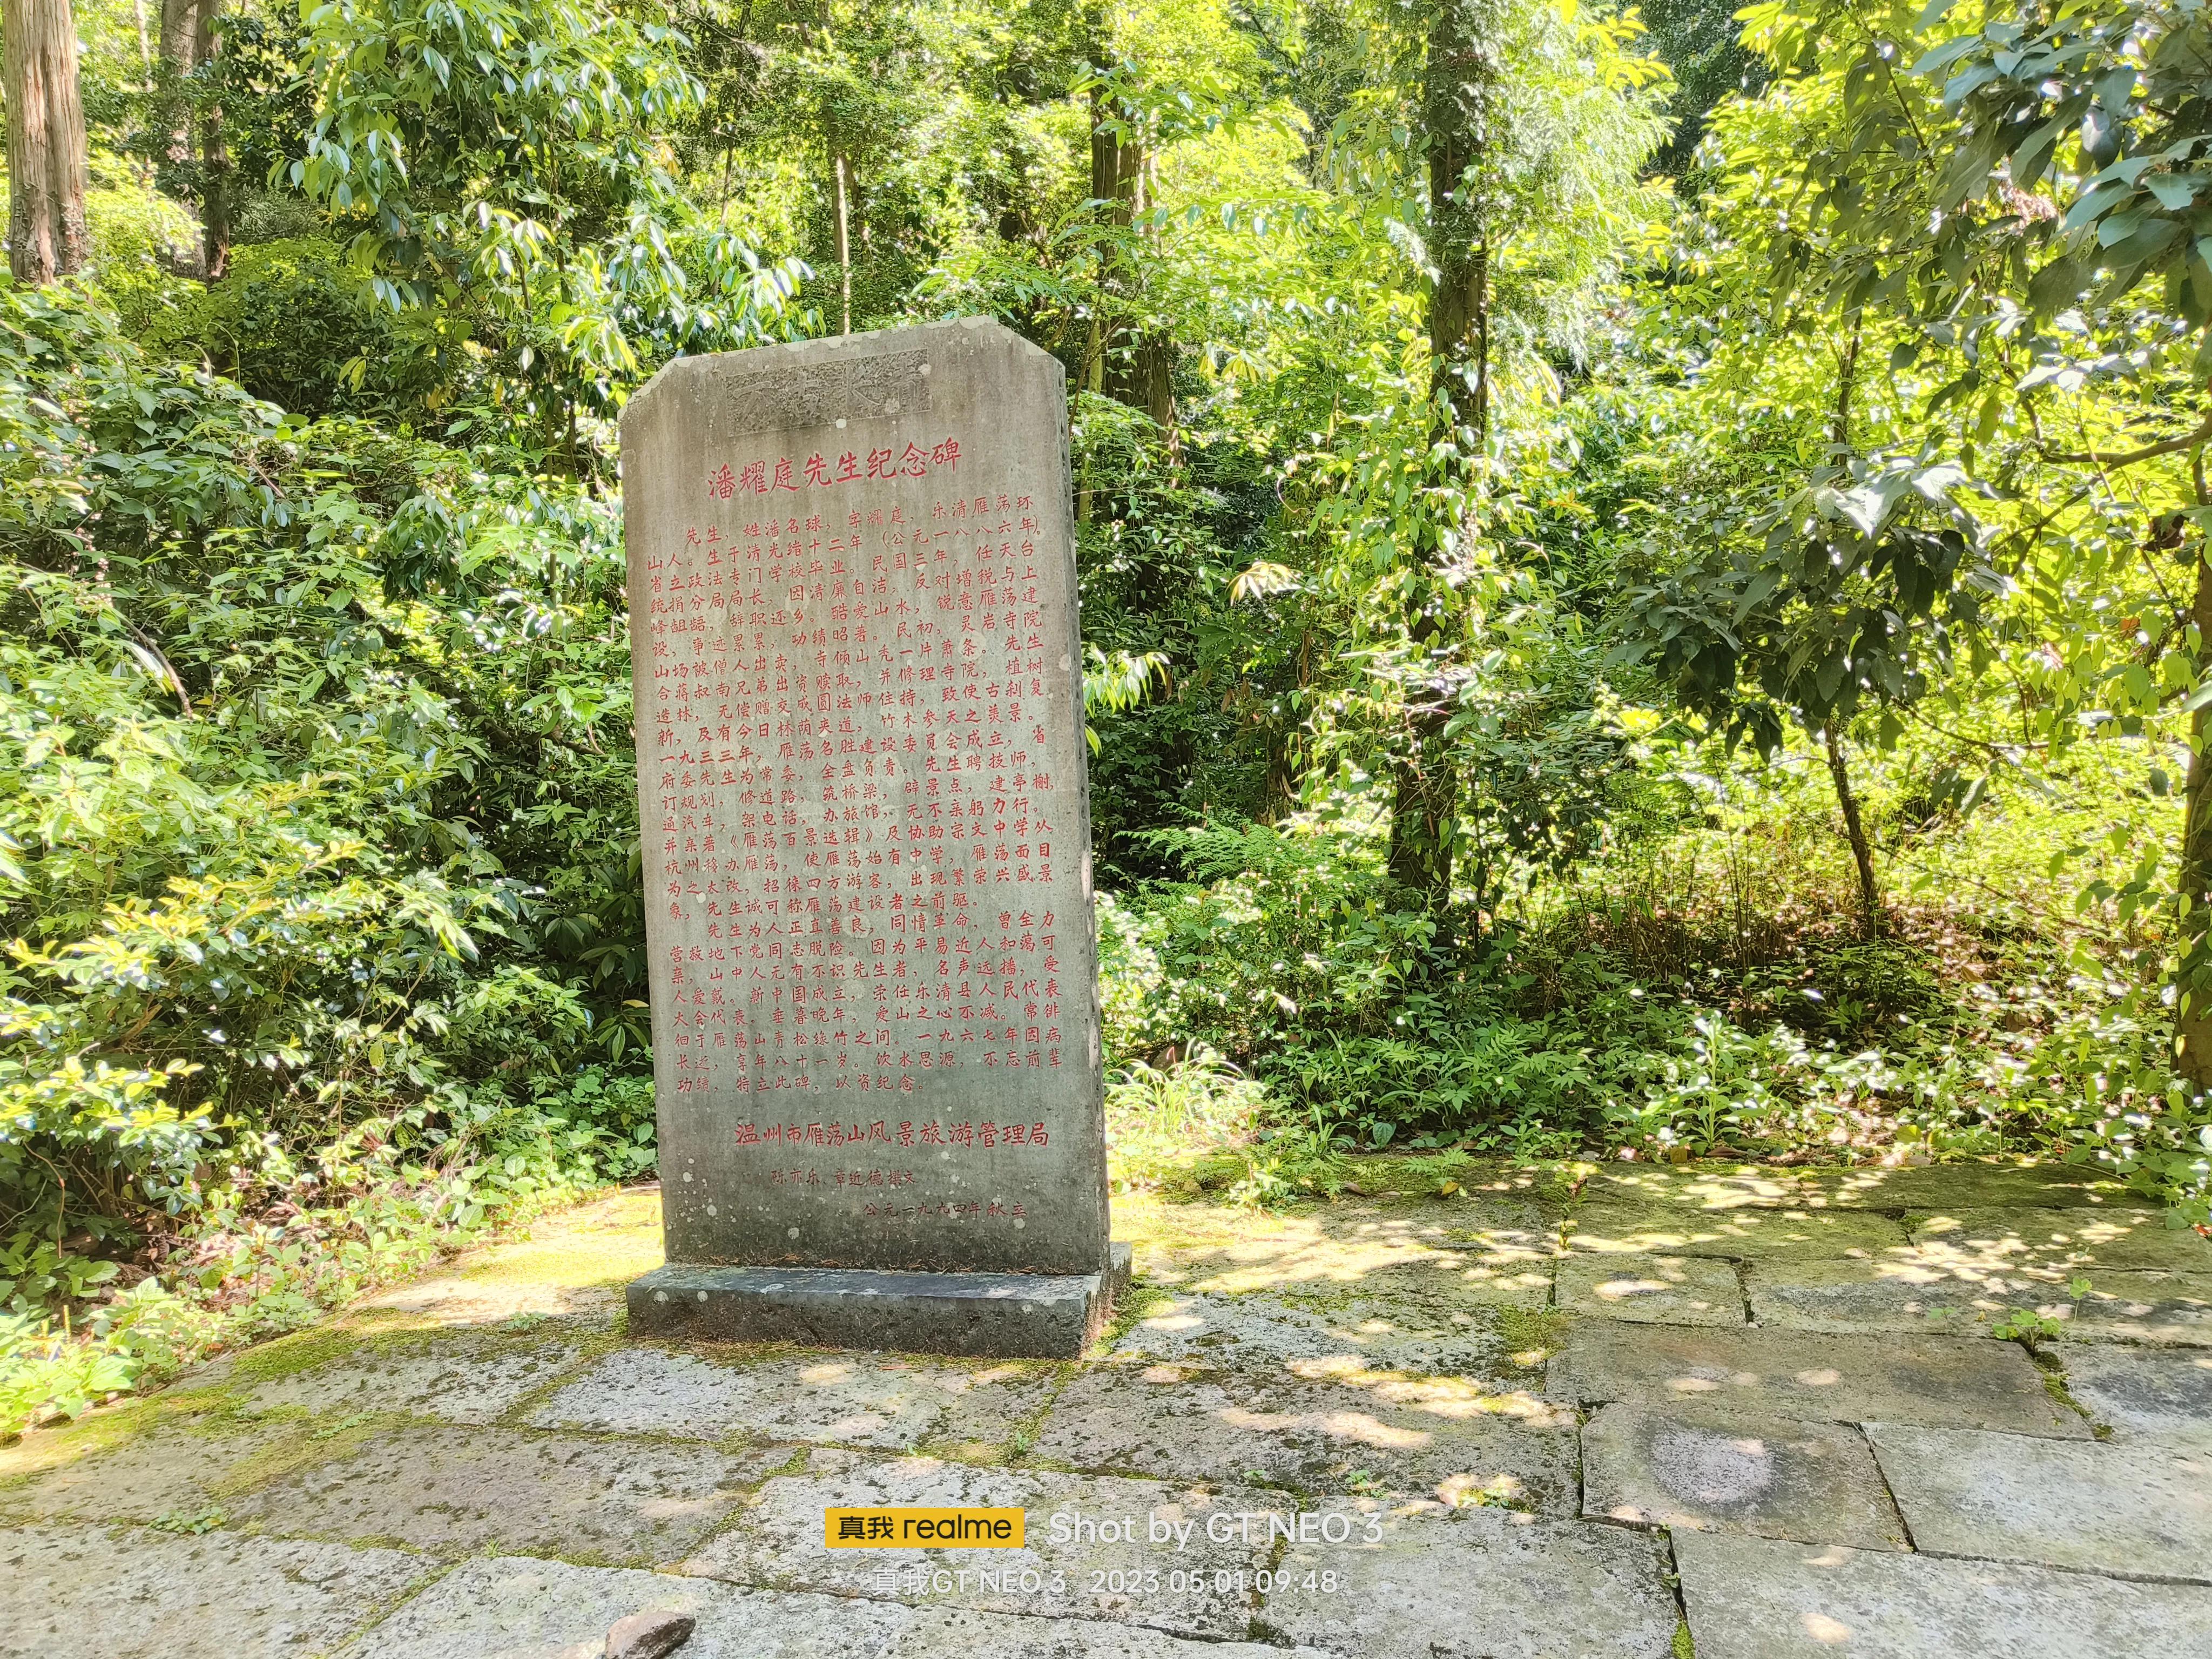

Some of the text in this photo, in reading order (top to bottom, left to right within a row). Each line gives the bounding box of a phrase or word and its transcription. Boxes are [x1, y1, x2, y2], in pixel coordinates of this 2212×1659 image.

[707, 437, 962, 499] 潘耀庭先生纪念碑
[734, 1121, 1049, 1148] 温州市雁荡山风景旅游管理局
